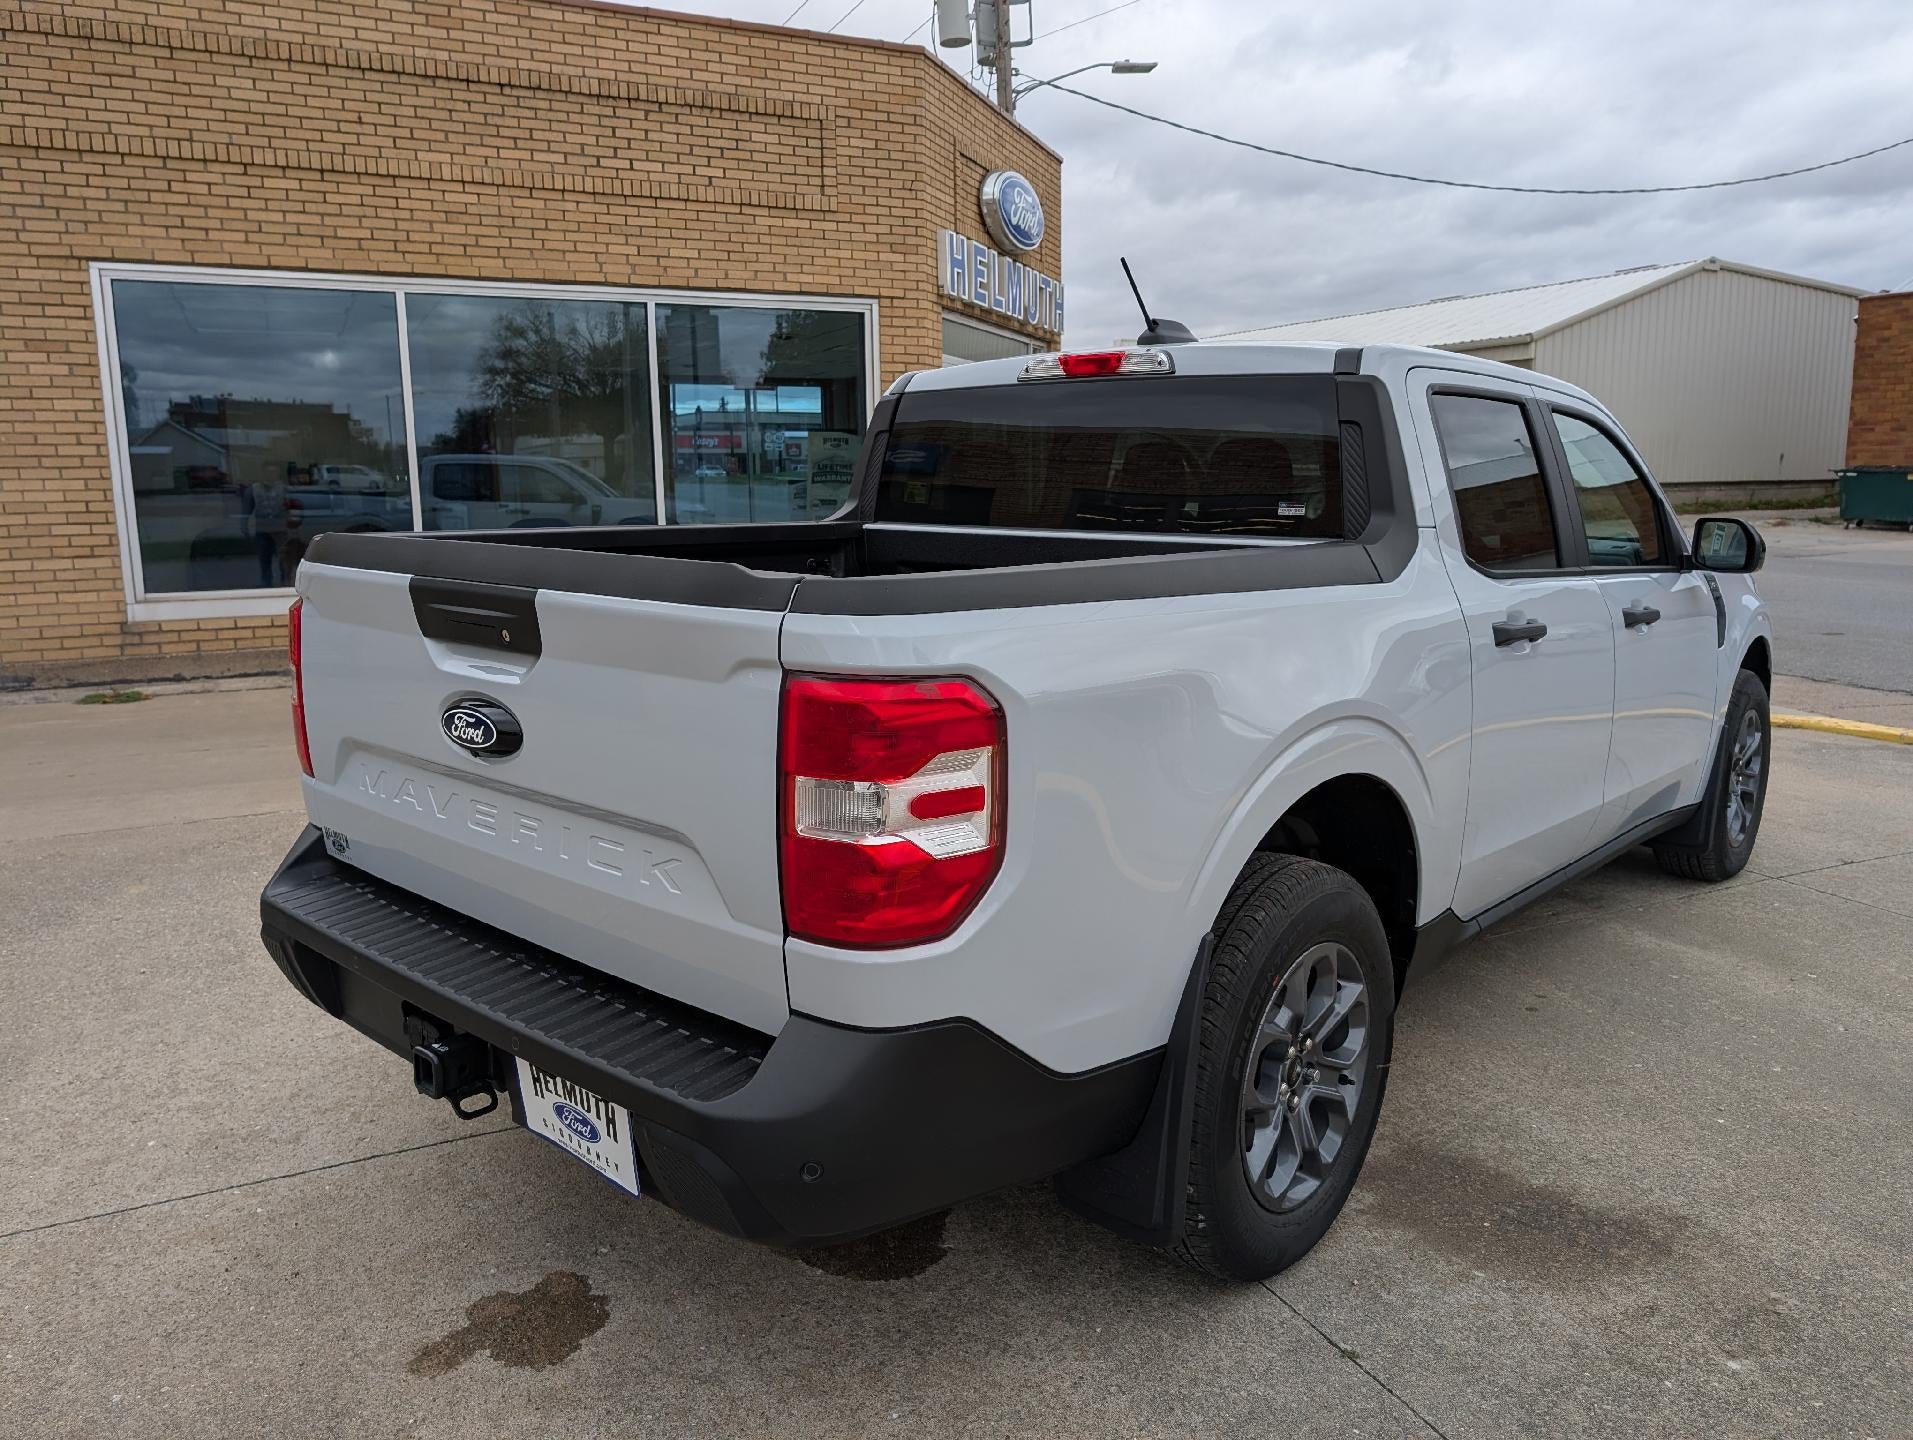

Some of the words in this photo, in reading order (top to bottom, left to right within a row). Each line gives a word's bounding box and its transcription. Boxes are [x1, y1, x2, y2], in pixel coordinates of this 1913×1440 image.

[1010, 186, 1041, 237] Ford
[944, 230, 1064, 334] HELMUTH
[451, 713, 485, 743] Ford
[358, 762, 684, 895] MAVERICK
[528, 1062, 619, 1144] HELMUTH
[562, 1107, 592, 1139] Ford
[543, 1118, 620, 1173] SIGOURNEY
